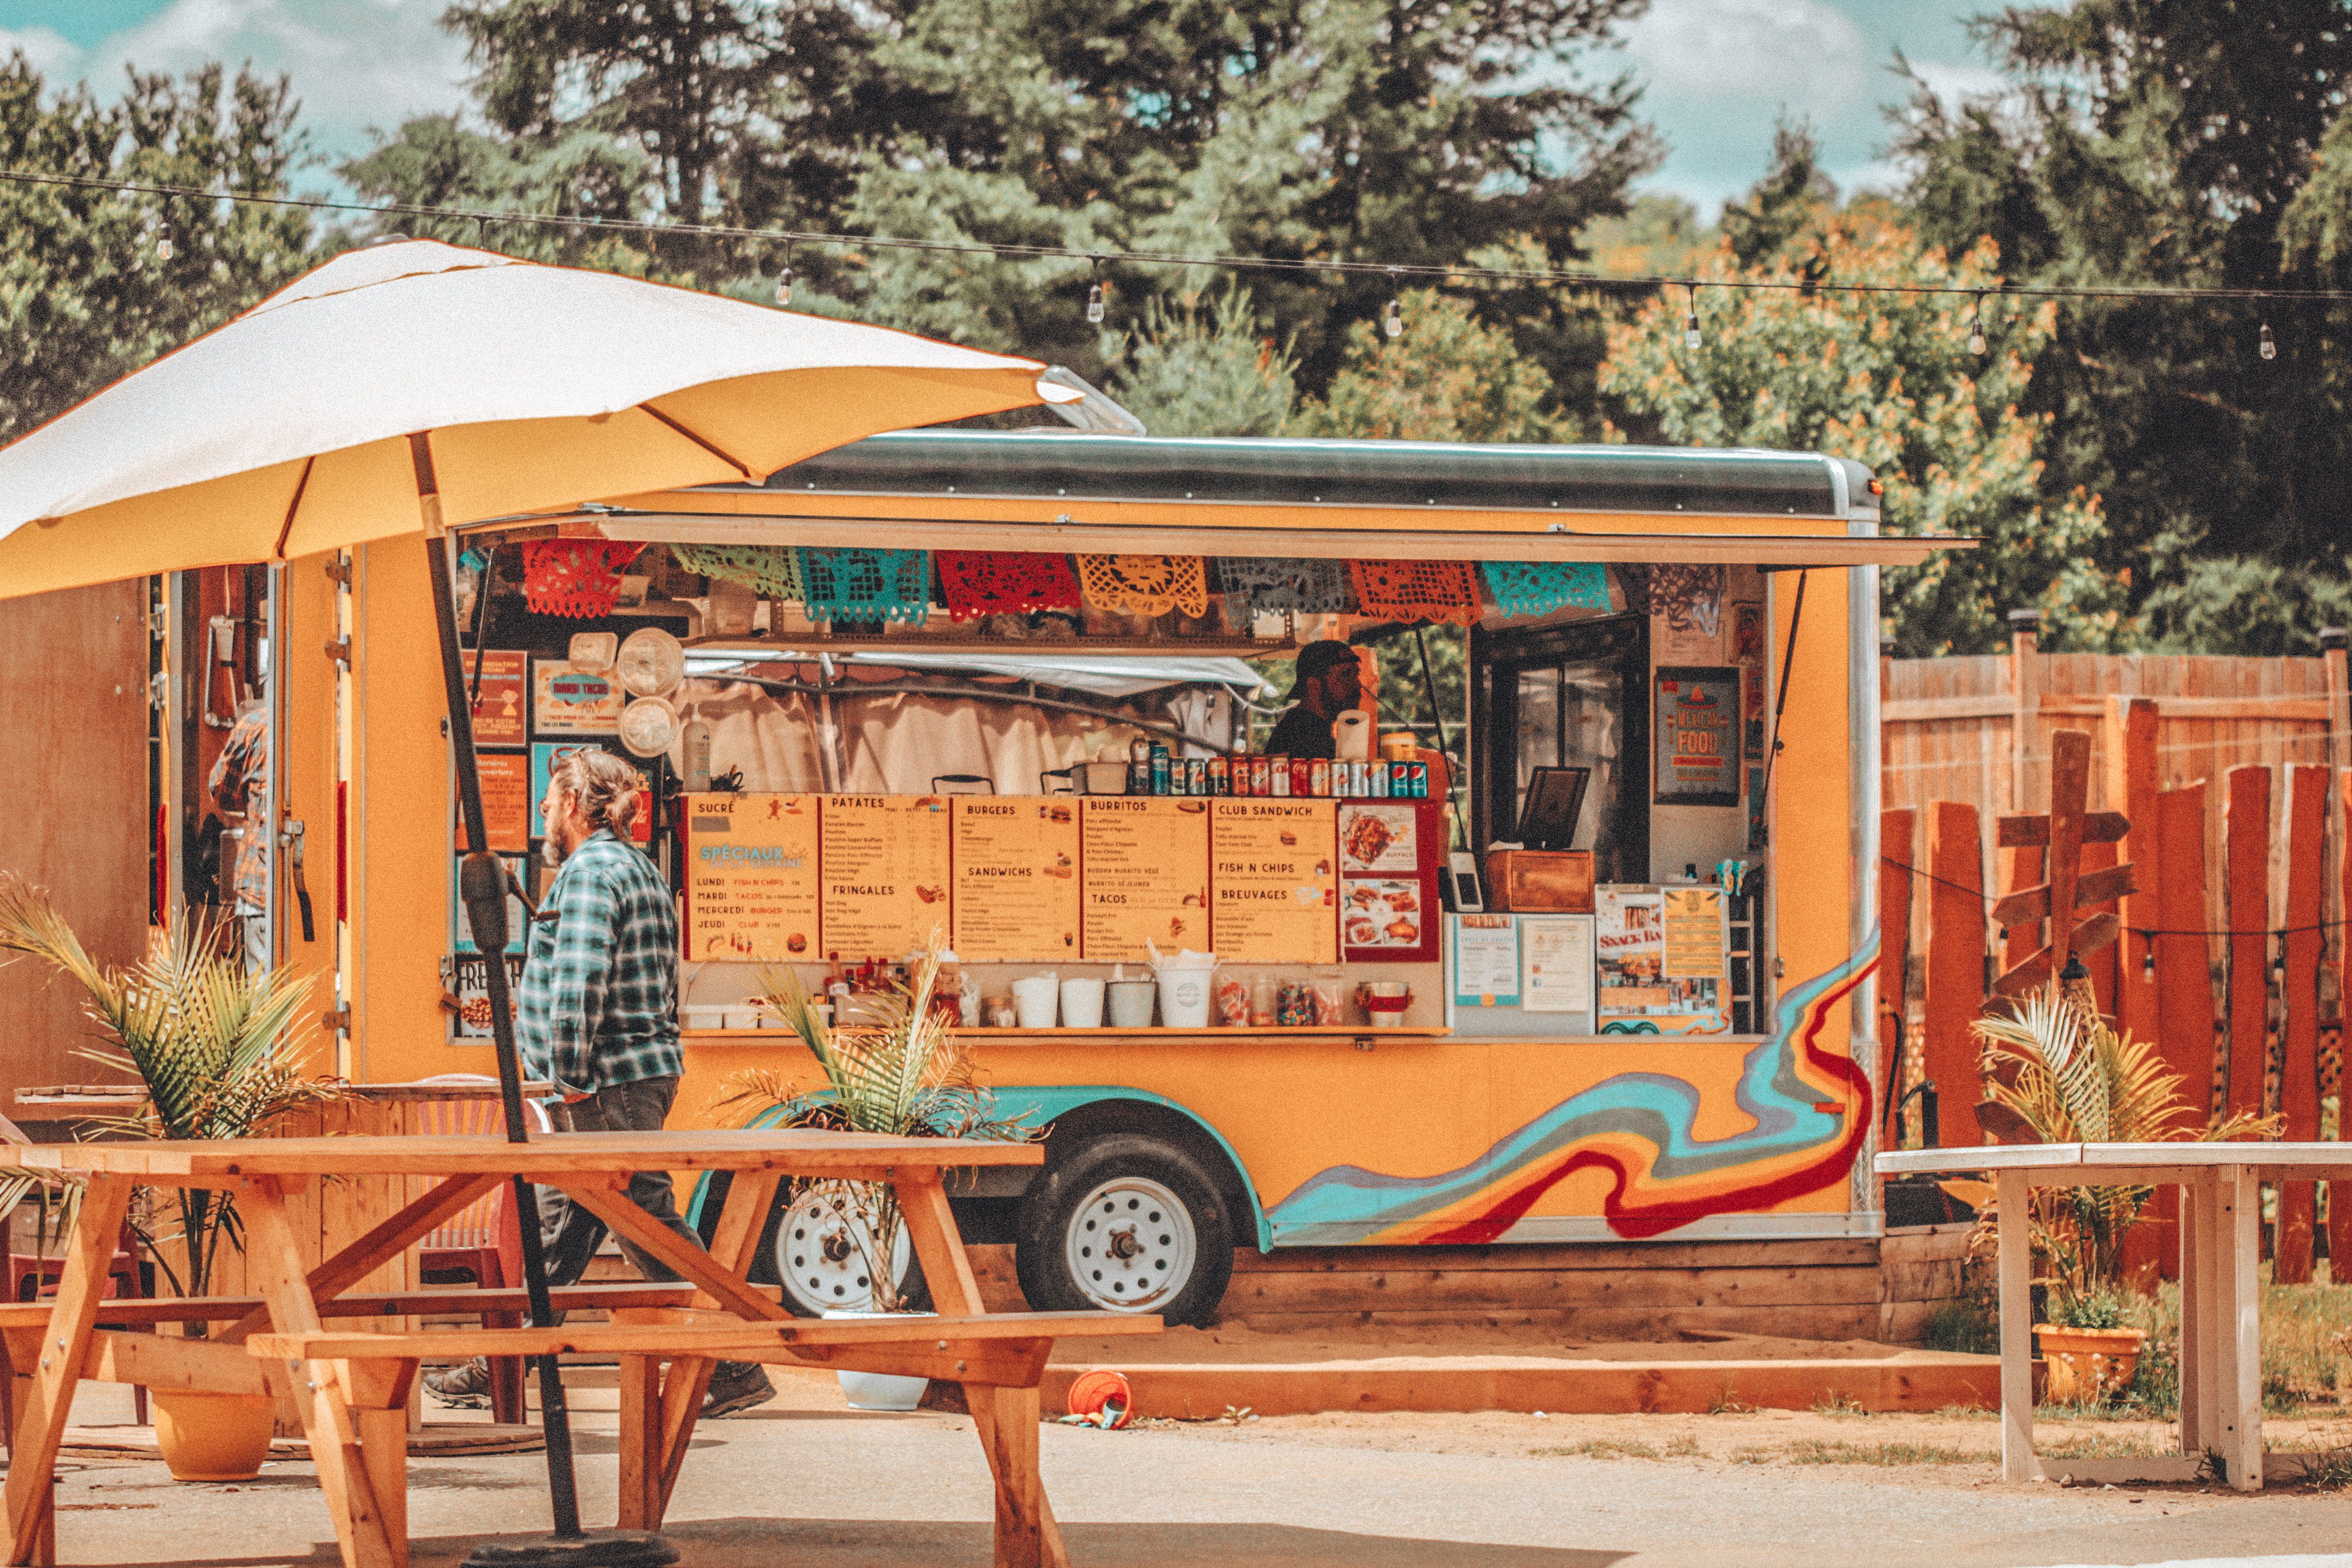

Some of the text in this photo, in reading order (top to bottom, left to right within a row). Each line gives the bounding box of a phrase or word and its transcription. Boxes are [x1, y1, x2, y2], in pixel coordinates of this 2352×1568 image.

[1677, 709, 1719, 728] MEXICAN
[1677, 730, 1719, 754] FOOD
[698, 801, 734, 813] SUCRÉ
[832, 797, 885, 808] PATATES
[1090, 801, 1147, 811] BURRITOS
[967, 806, 1016, 815] BURGERS
[1218, 805, 1313, 816] CLUB SANDWICH
[701, 843, 783, 860] SPÉCIAUX
[968, 867, 1032, 877] SANDWICHS
[1218, 862, 1295, 873] FISH N CHIPS
[833, 885, 895, 895] FRINGALES
[1221, 889, 1288, 900] BREUVAGES
[1092, 894, 1127, 904] TACOS
[1599, 933, 1642, 949] SNACK
[459, 962, 521, 990] FREH
